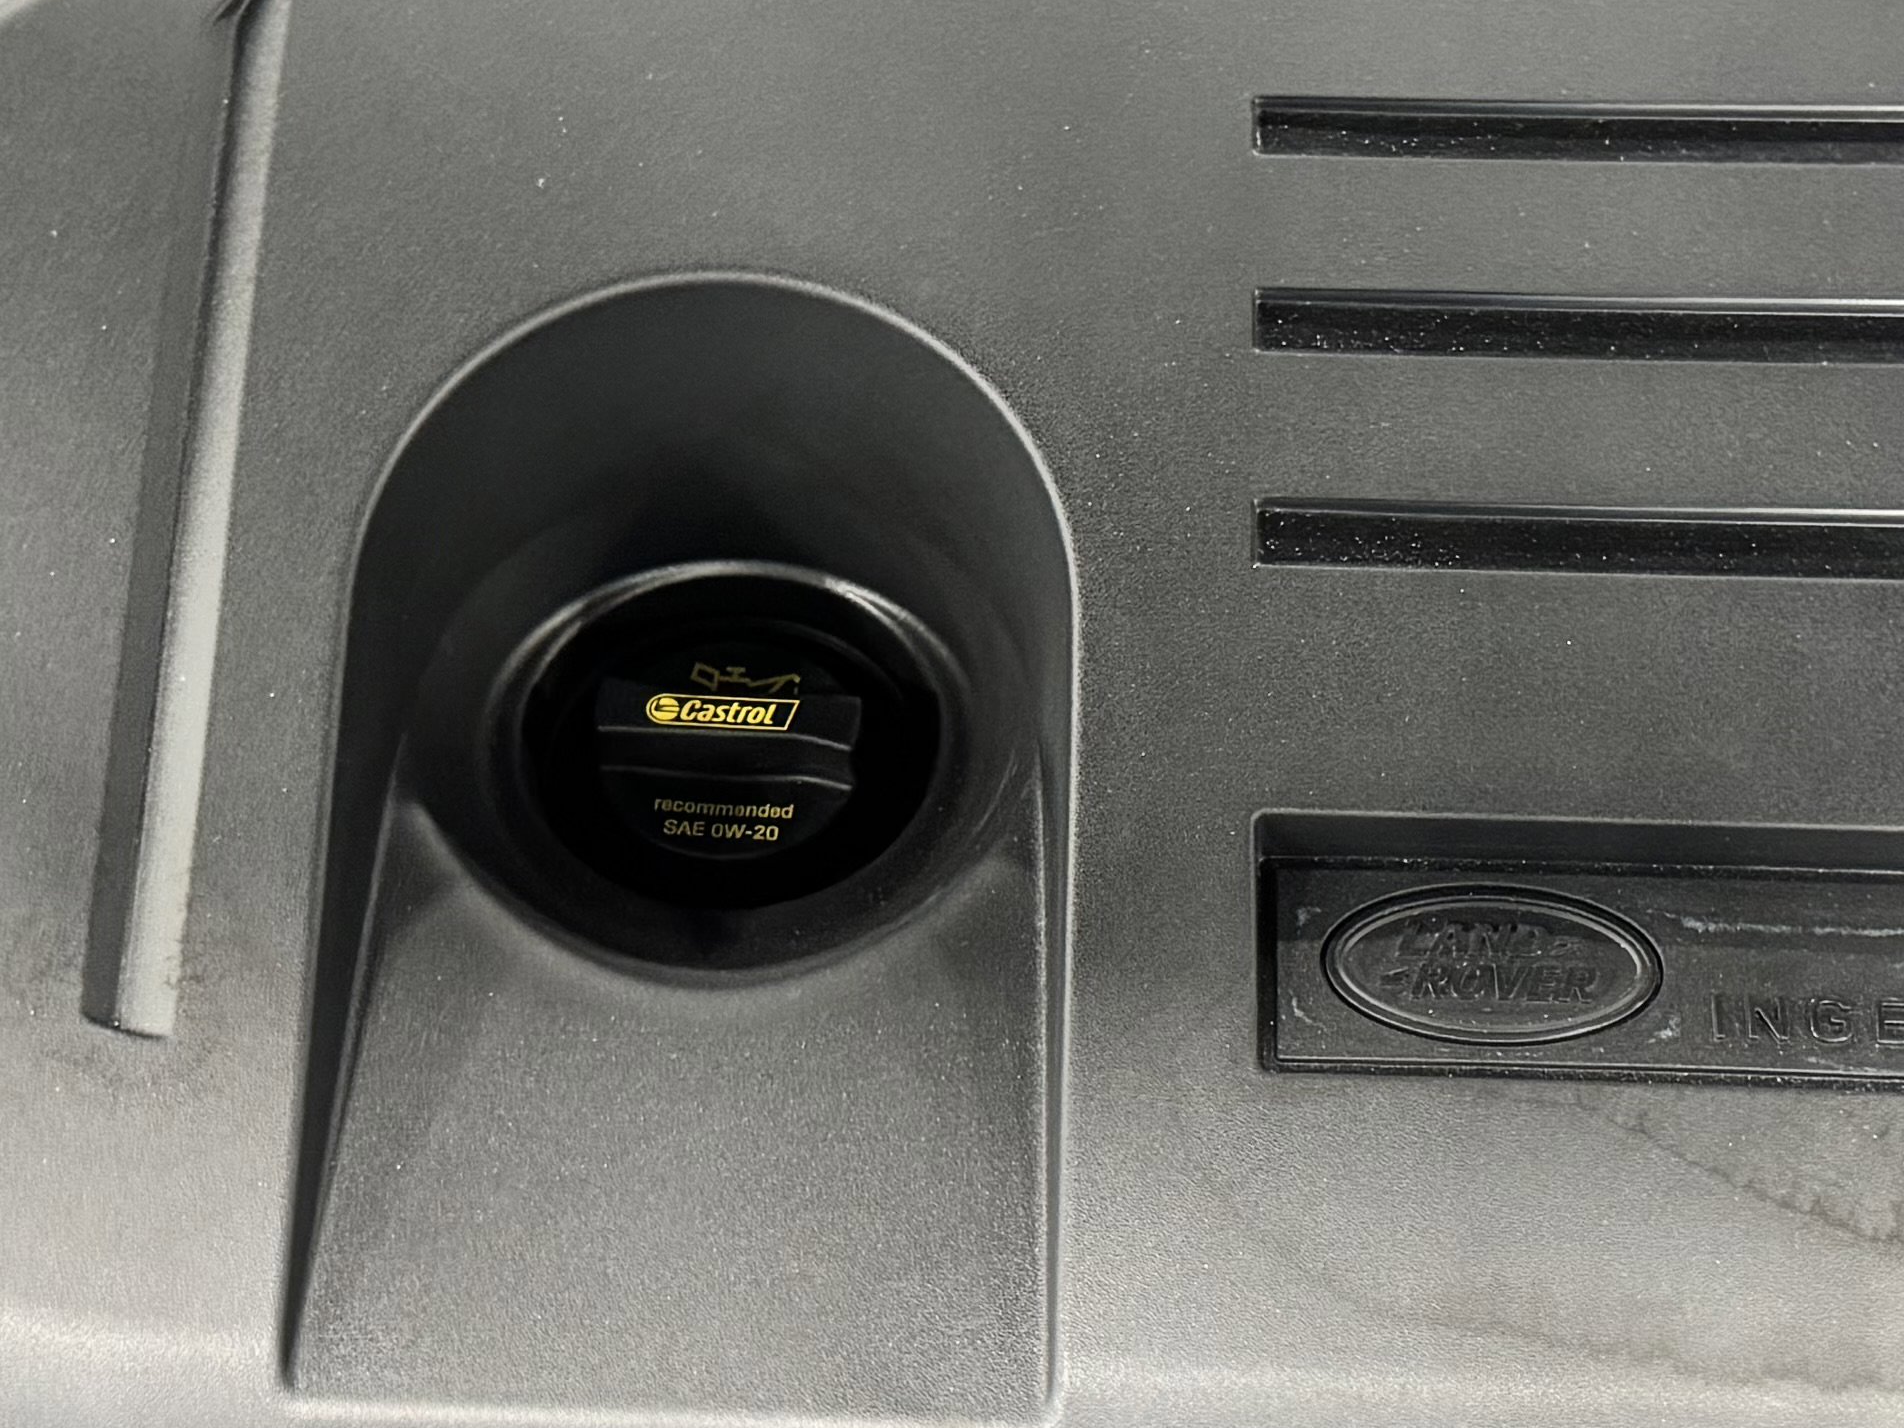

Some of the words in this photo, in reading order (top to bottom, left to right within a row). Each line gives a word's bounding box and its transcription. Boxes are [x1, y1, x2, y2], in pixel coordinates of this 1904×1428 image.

[680, 700, 777, 725] Castrol
[653, 798, 795, 819] recommended
[663, 819, 705, 837] SAE
[711, 822, 780, 841] 0W-20
[1395, 919, 1544, 958] LAND
[1409, 962, 1595, 1003] ROVER
